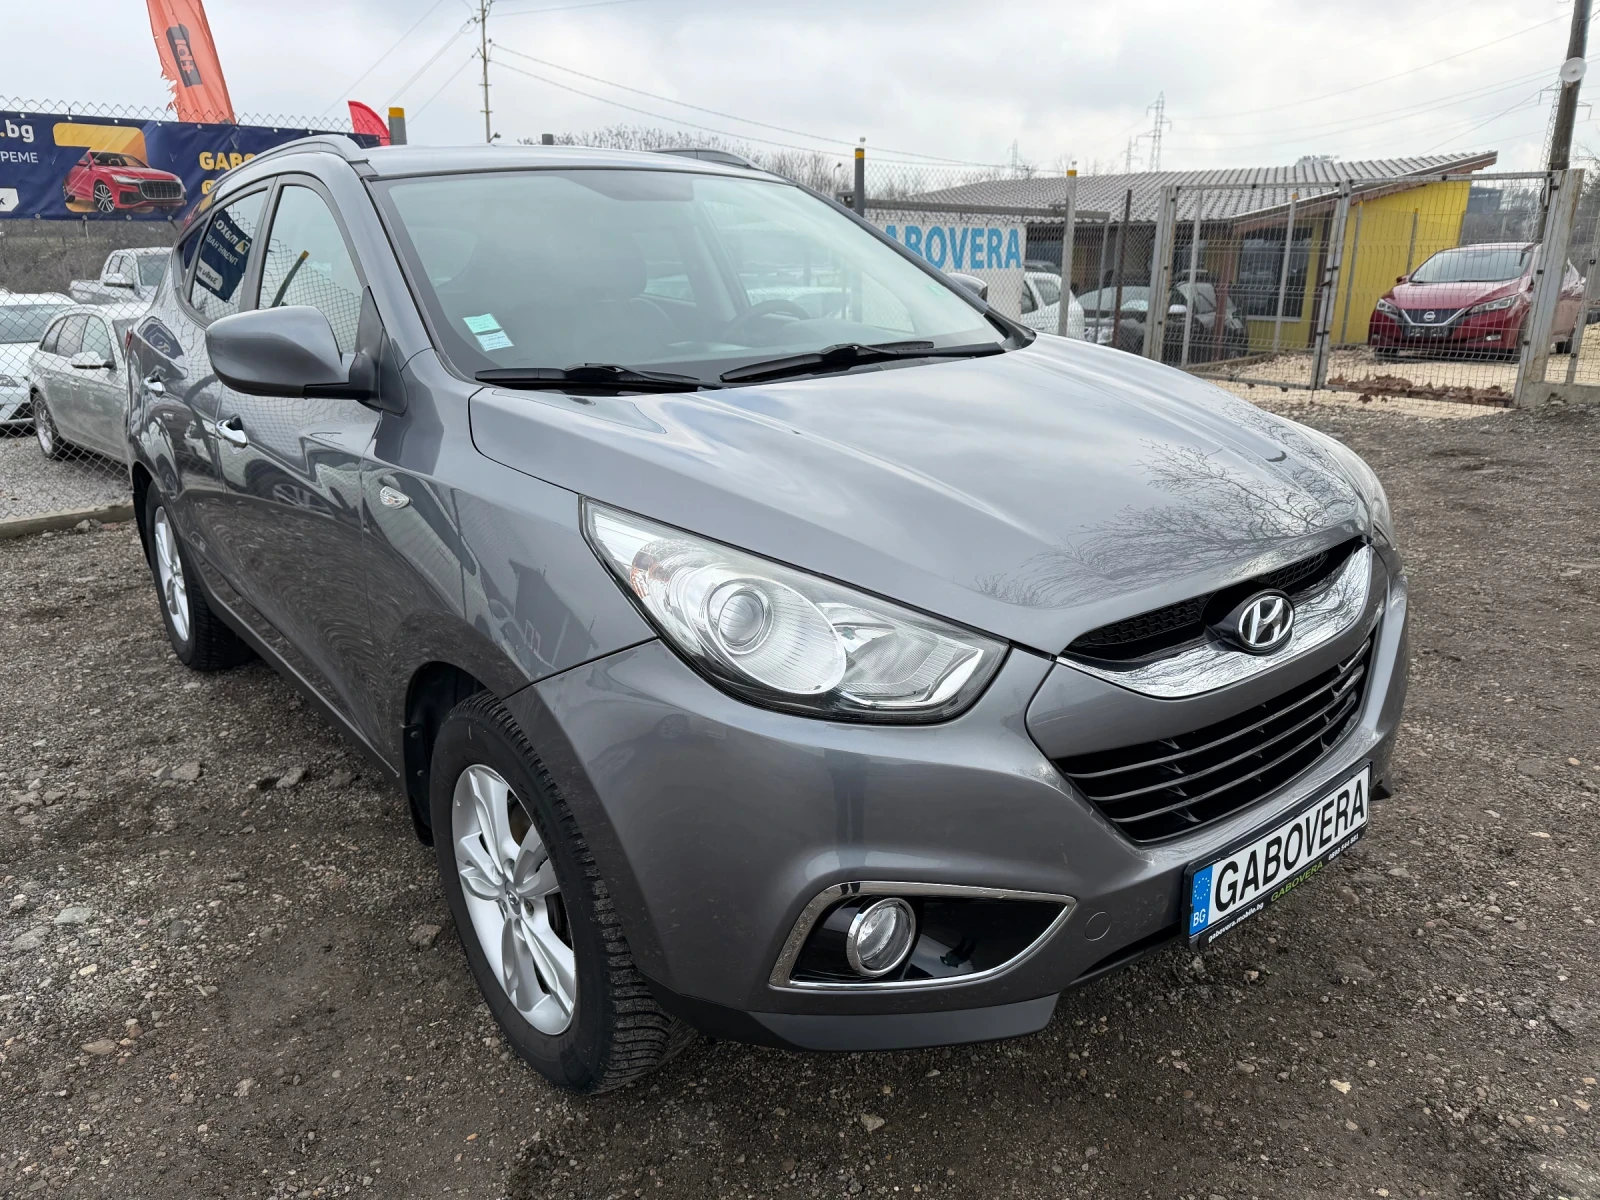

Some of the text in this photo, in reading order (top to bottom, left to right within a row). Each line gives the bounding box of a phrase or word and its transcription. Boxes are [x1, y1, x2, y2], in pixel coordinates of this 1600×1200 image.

[0, 119, 34, 143] .bg
[0, 150, 39, 163] РЕМЕ
[885, 225, 1022, 269] BOVERA
[1192, 779, 1365, 927] BG GABOVERA
[1271, 860, 1323, 902] GABOVERA
